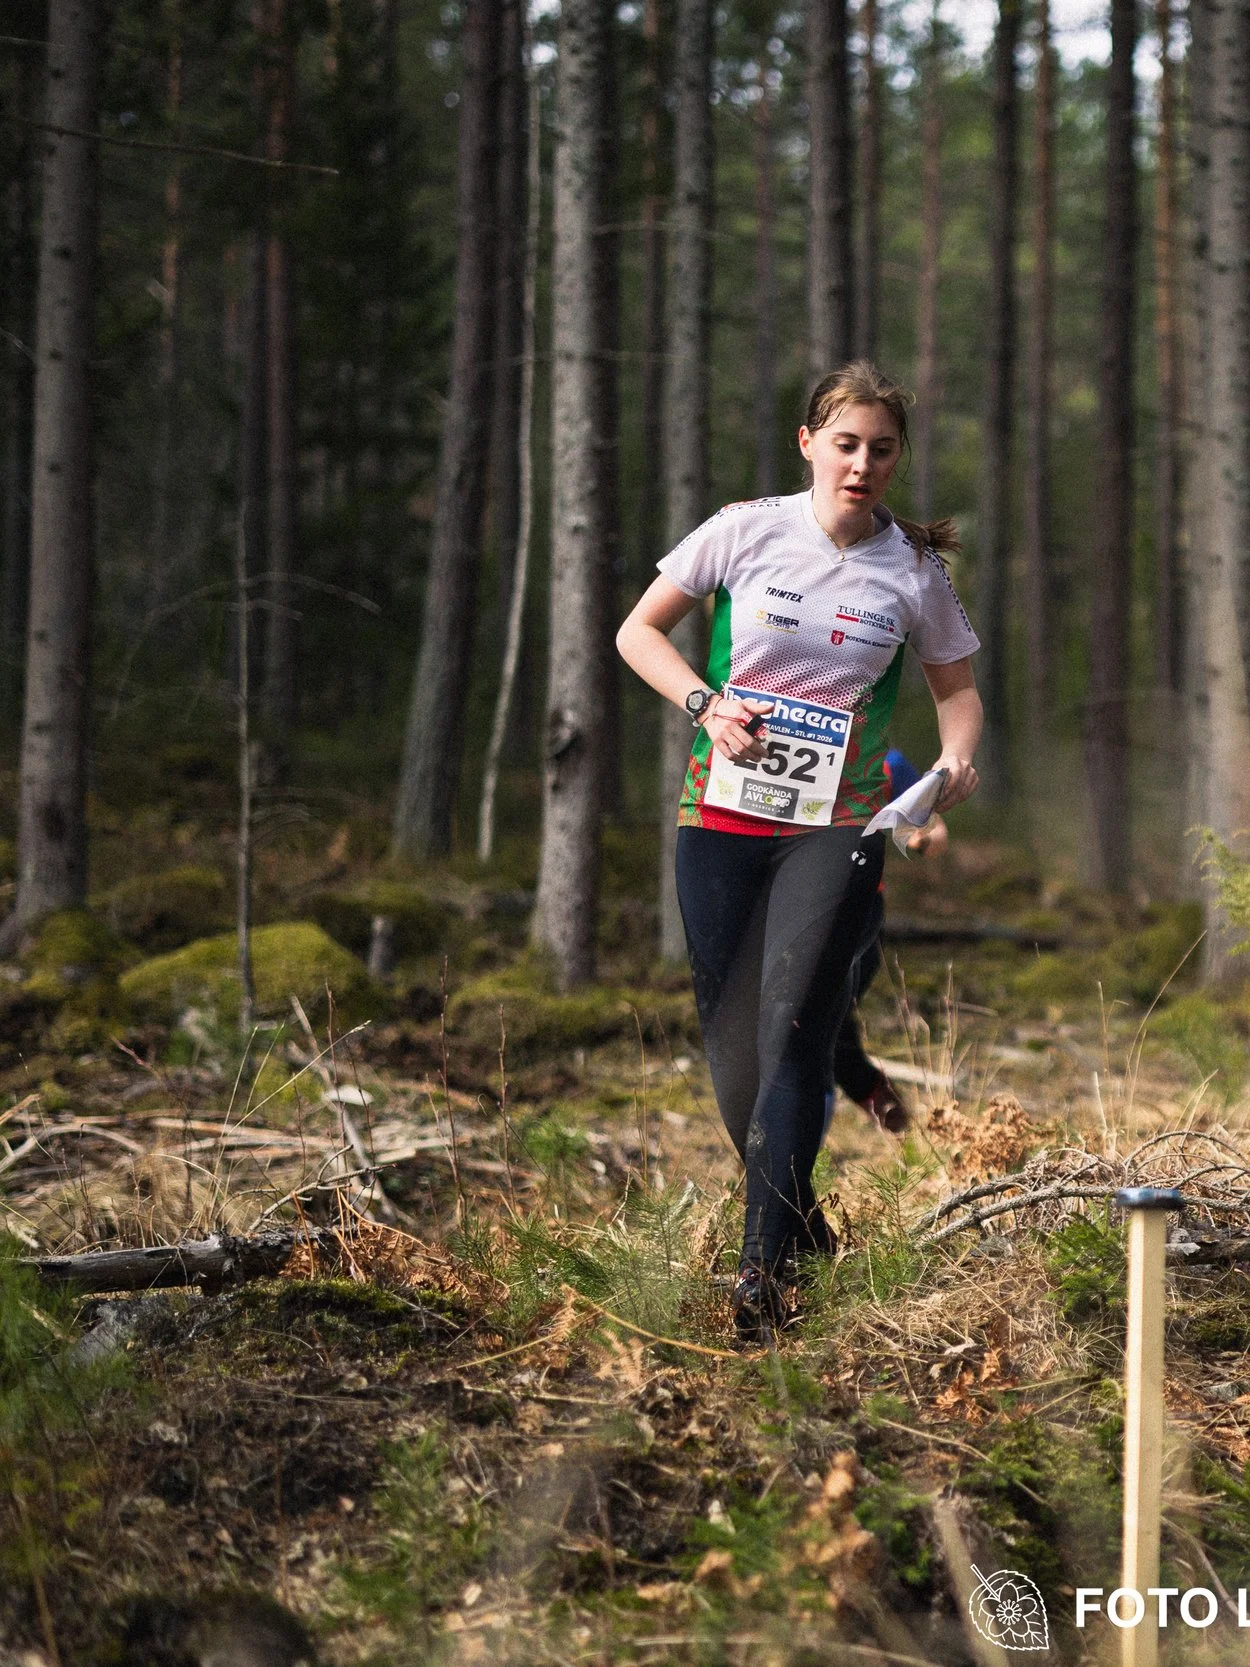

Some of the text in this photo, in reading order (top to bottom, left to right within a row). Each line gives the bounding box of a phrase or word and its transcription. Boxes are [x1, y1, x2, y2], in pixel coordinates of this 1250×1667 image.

[765, 587, 804, 603] TRIMTEX
[767, 613, 799, 627] TIGER
[838, 605, 886, 623] TULLINGE
[795, 730, 806, 738] STL
[816, 734, 833, 743] 2026
[733, 741, 836, 784] 52 1
